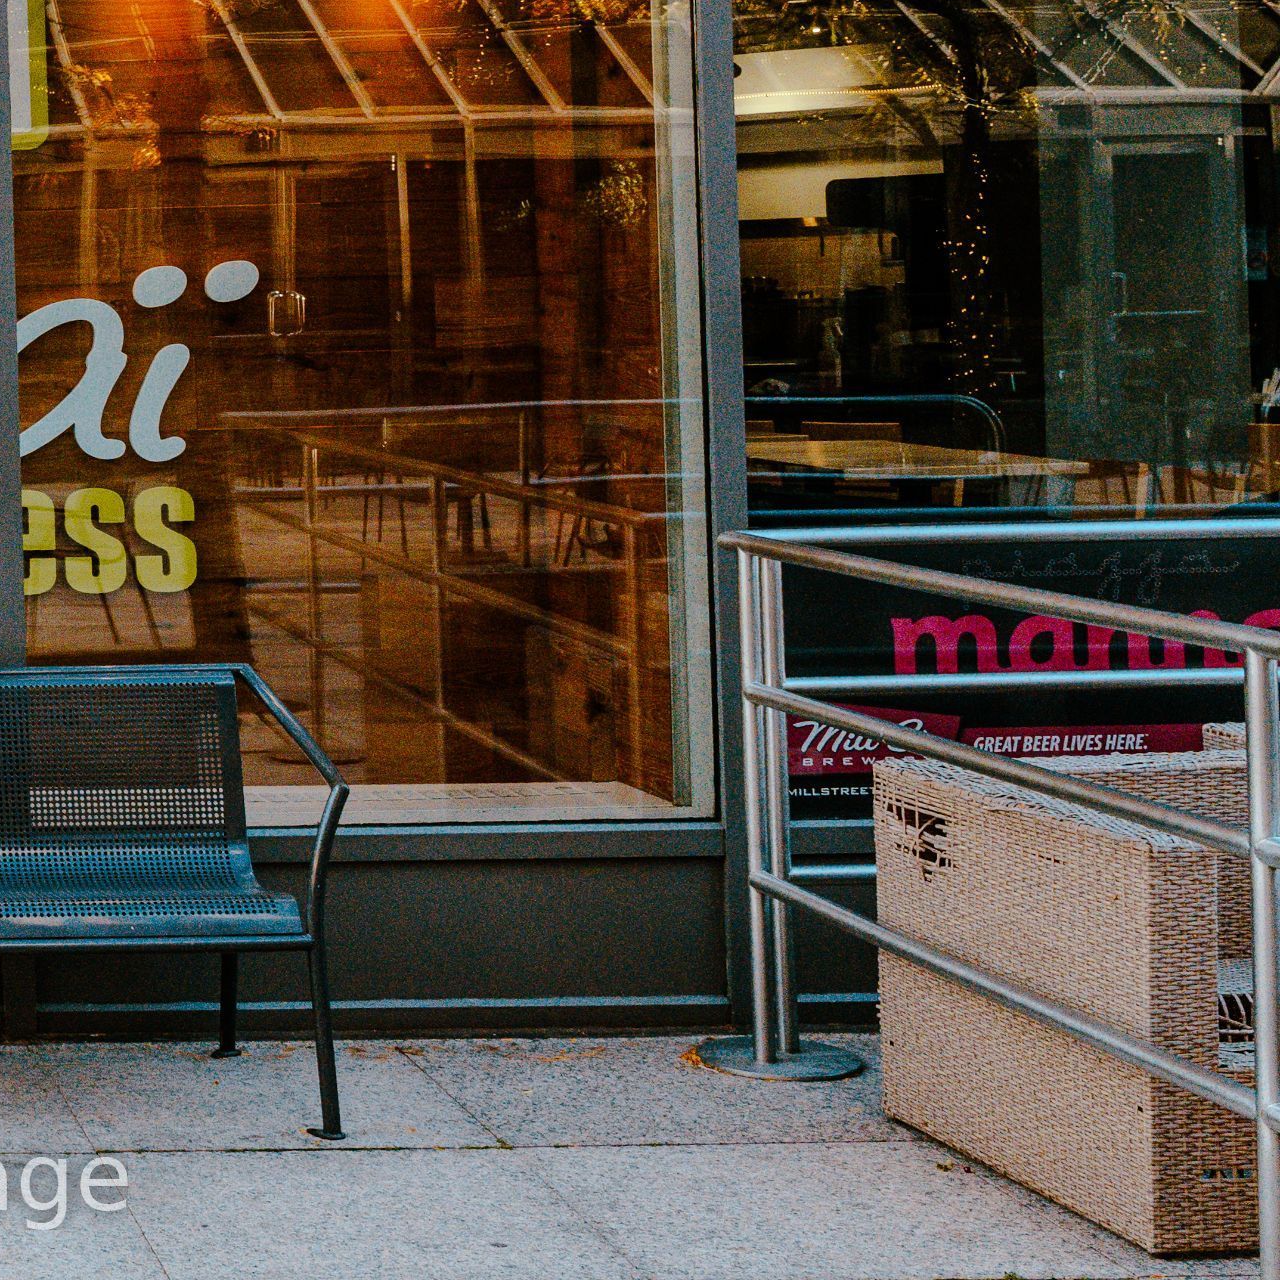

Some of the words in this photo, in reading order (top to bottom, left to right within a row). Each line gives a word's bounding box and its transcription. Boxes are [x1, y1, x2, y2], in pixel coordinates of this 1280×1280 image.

[973, 736, 1022, 753] GREAT
[1023, 735, 1060, 752] BEER
[1062, 734, 1102, 751] LIVES
